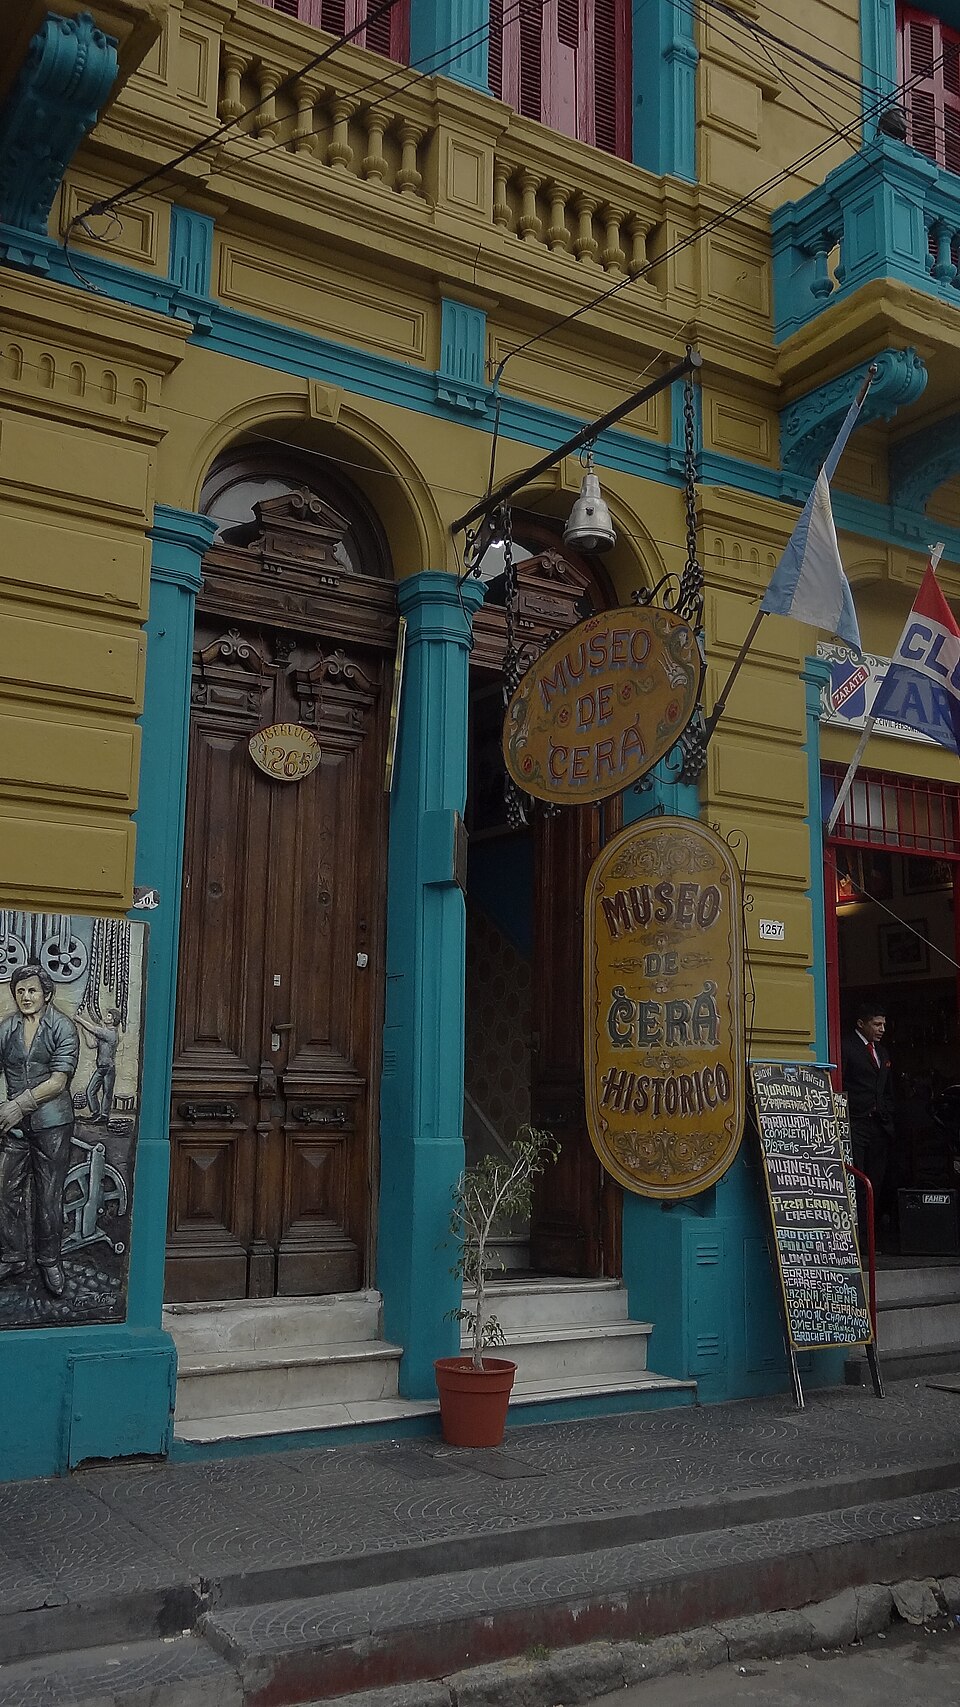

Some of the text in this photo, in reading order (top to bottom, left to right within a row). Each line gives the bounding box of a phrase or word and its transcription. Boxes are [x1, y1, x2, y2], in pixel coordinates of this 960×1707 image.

[538, 628, 652, 710] MUSEO
[833, 671, 866, 704] ZARATE
[576, 684, 614, 732] DE
[548, 713, 647, 786] CERA
[600, 880, 722, 940] MUSEO
[760, 923, 783, 936] 1257
[642, 951, 680, 978] DE
[606, 979, 722, 1050] CERA
[754, 1066, 772, 1081] SHOW
[756, 1083, 802, 1098] CHORIPAN
[760, 1116, 810, 1130] PARRILLADA
[767, 1158, 820, 1176] MILANESA
[777, 1174, 843, 1193] NAPOLITANA
[785, 1209, 833, 1222] CASERA
[781, 1253, 813, 1266] LOMO
[787, 1299, 830, 1312] TORTILLA
[789, 1309, 812, 1320] LOMO
[790, 1319, 827, 1332] OMELET
